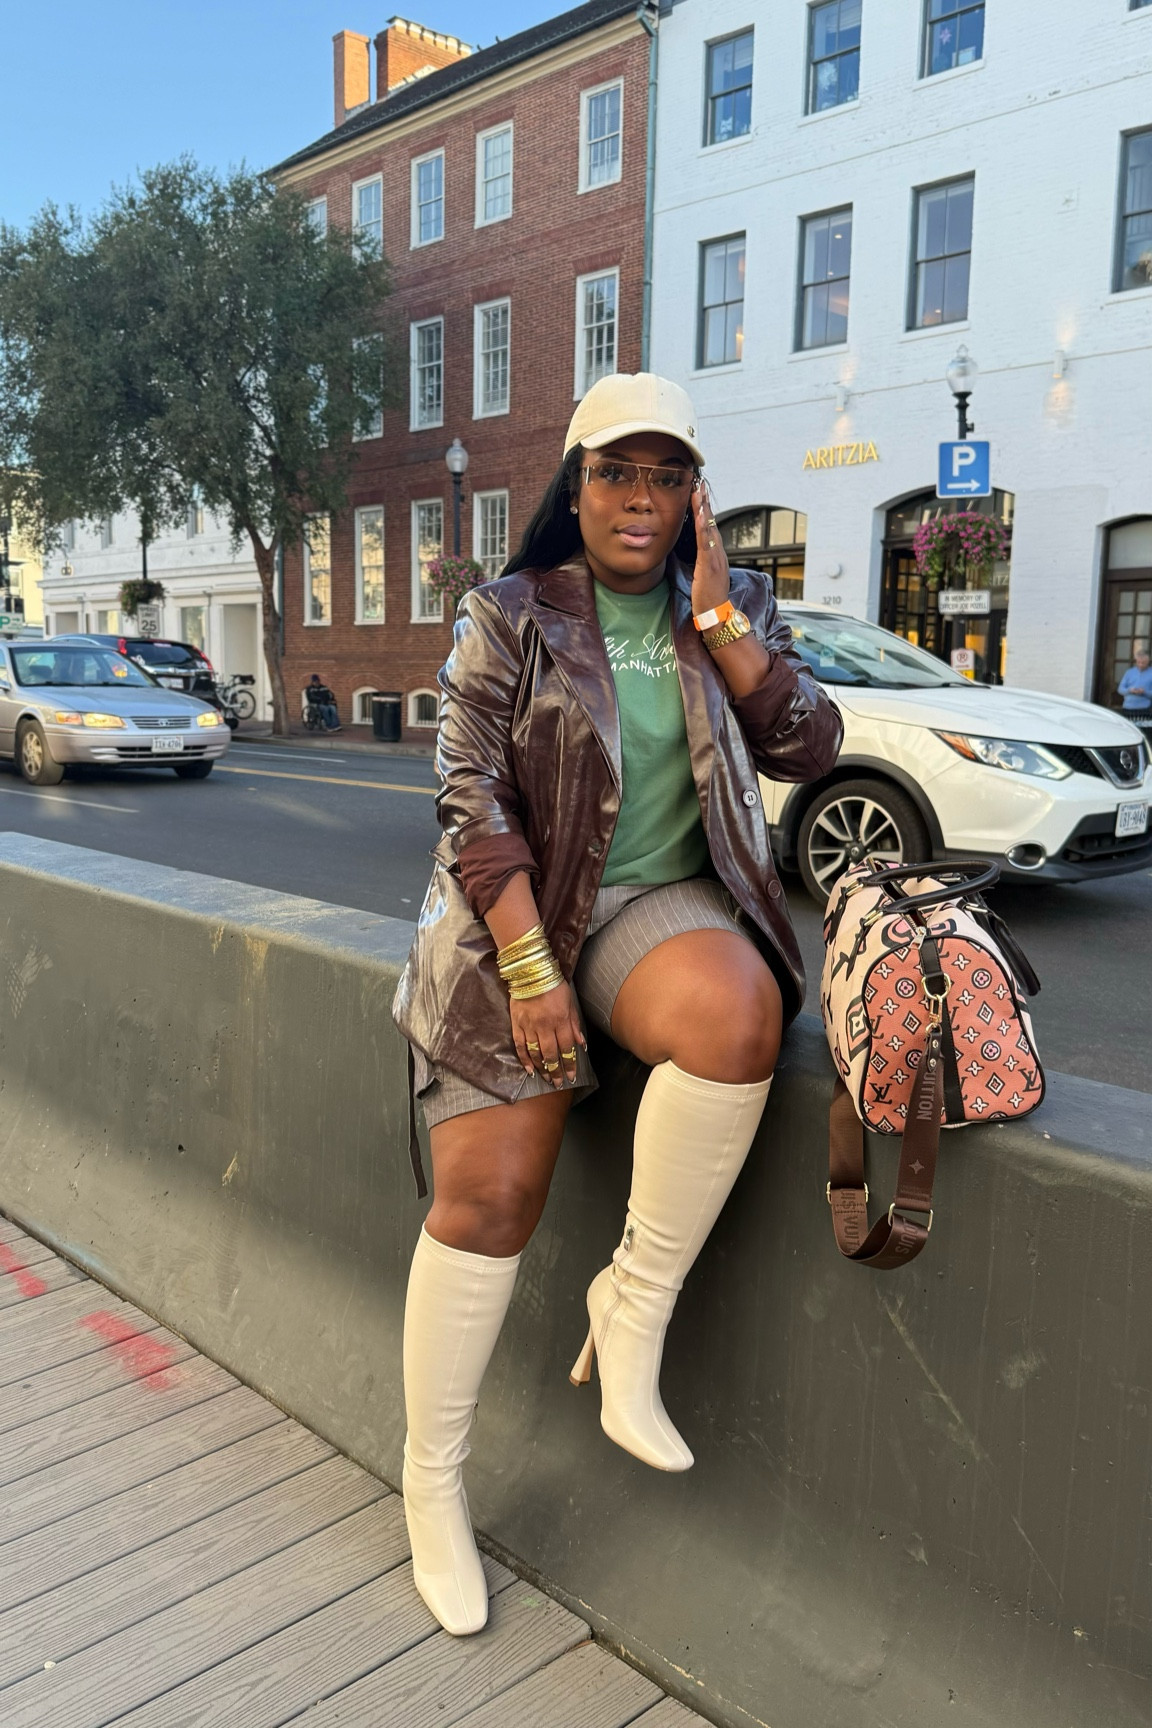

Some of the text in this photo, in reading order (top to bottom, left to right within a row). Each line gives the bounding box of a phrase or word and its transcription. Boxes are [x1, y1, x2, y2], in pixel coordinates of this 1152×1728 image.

[802, 440, 879, 470] ARITZIA
[952, 446, 976, 477] P
[141, 619, 157, 631] 25
[916, 1071, 936, 1121] UITTON
